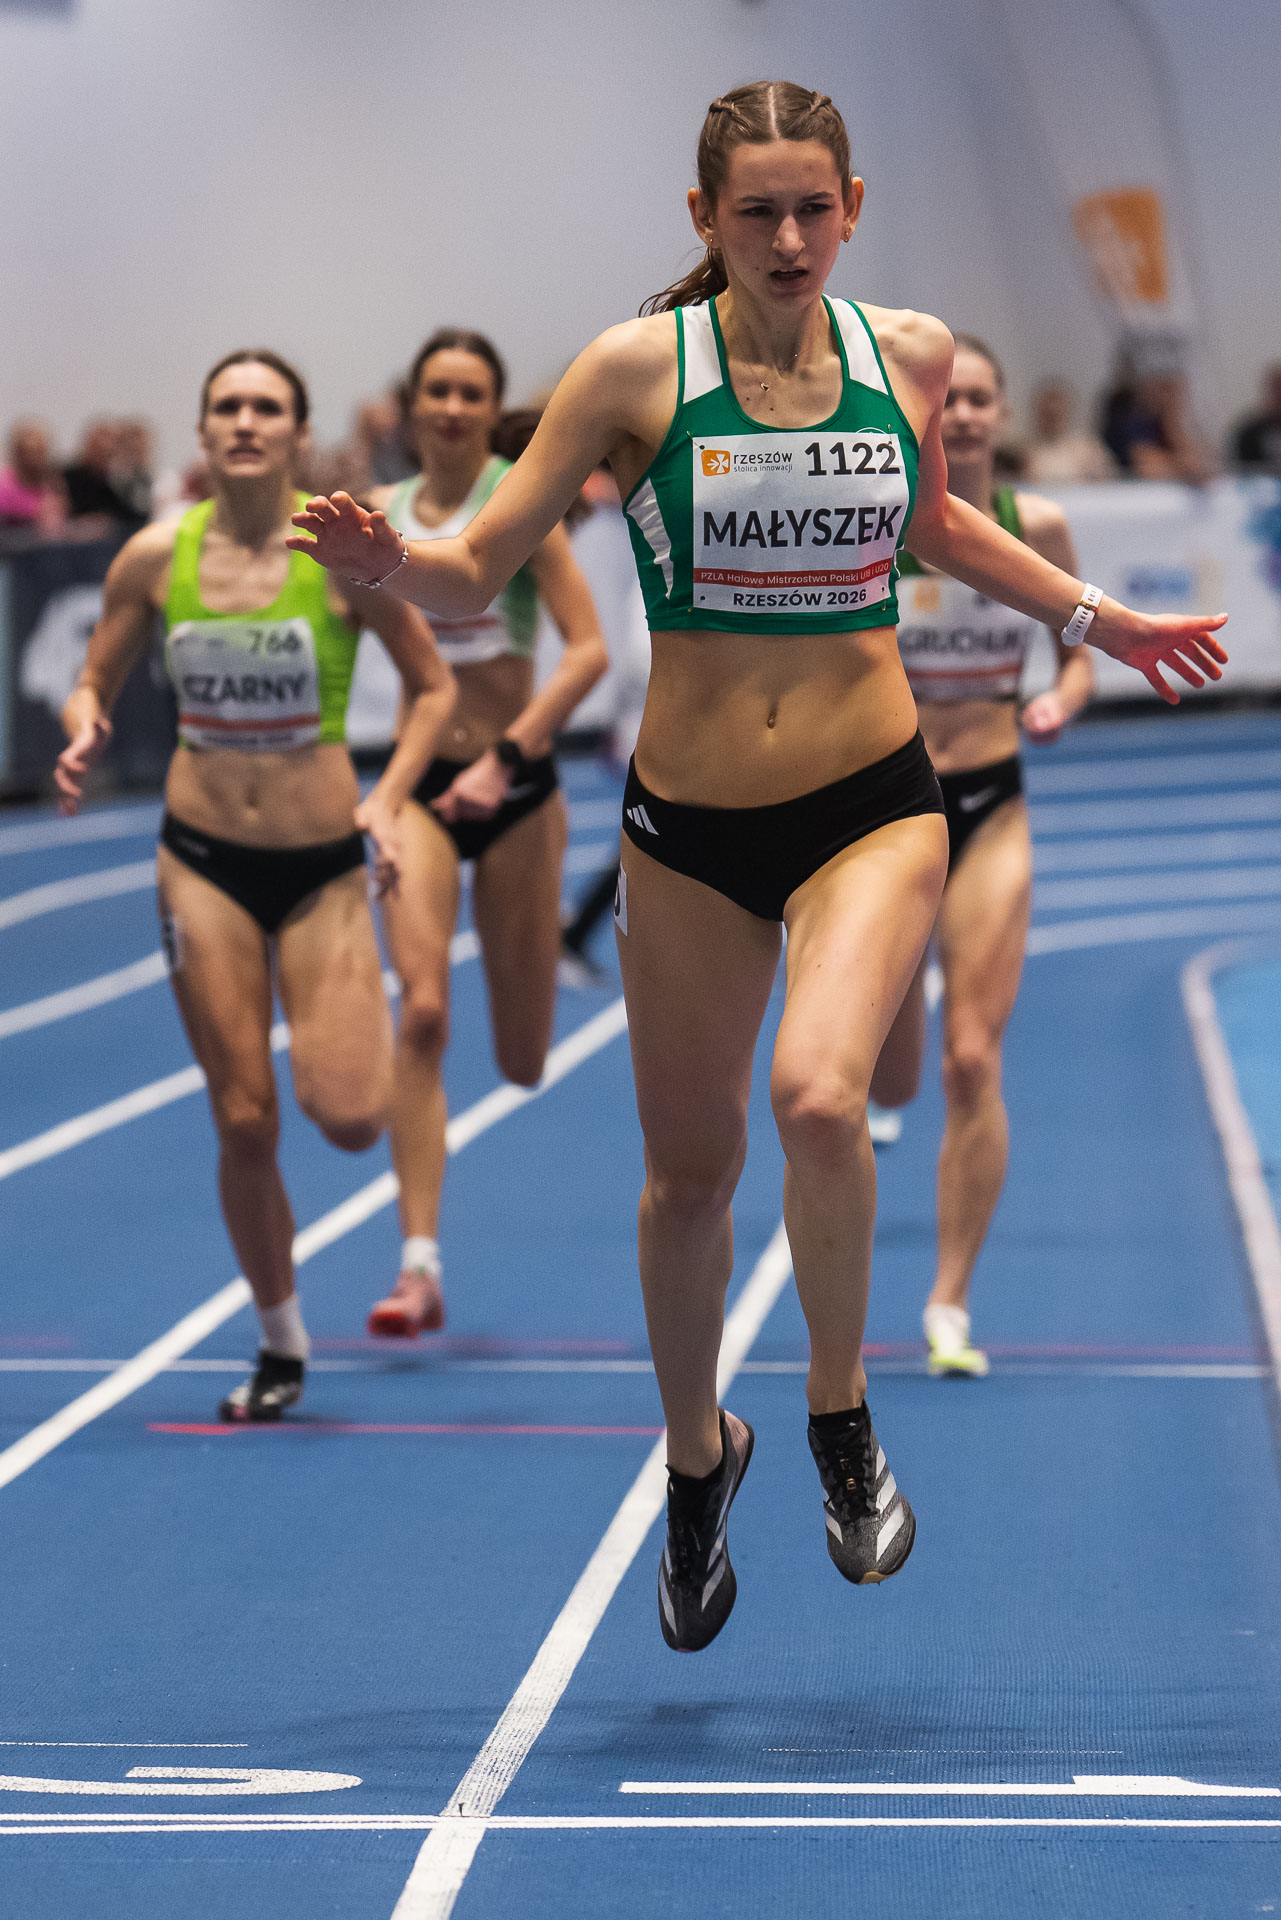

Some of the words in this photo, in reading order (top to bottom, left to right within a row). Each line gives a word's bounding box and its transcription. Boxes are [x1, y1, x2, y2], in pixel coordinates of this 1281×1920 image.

[733, 451, 793, 465] rzeszów
[734, 465, 758, 473] stolica
[759, 464, 793, 474] innowacji
[804, 442, 901, 477] 1122
[702, 505, 903, 549] MAŁYSZEK
[700, 572, 725, 582] PZLA
[727, 573, 765, 585] Halowe
[767, 573, 827, 585] Mistrzostwa
[829, 572, 859, 583] Polski
[859, 569, 872, 580] U18
[874, 562, 890, 576] U20
[733, 589, 823, 607] RZESZÓW
[826, 588, 867, 605] 2026
[183, 669, 309, 705] CZARNY
